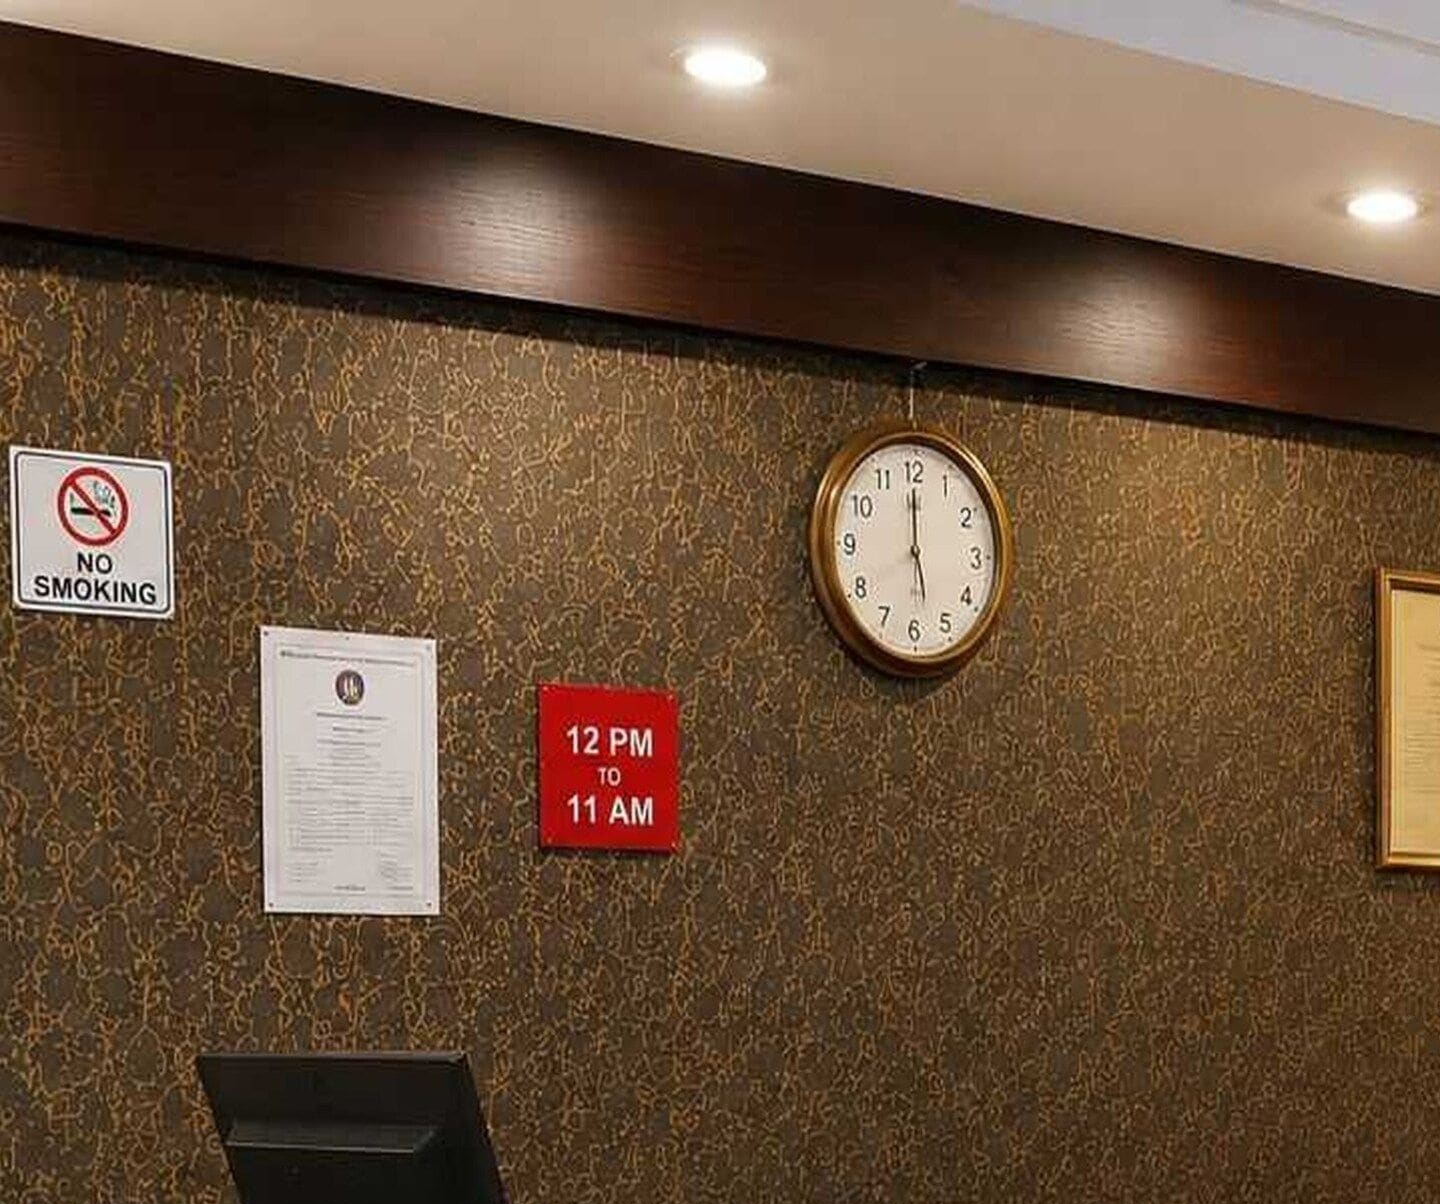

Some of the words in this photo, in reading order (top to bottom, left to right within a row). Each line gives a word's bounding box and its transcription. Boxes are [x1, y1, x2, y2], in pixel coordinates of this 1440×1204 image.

[876, 470, 890, 490] 11
[905, 461, 923, 484] 12
[942, 475, 948, 497] 1
[853, 495, 873, 518] 10
[960, 508, 972, 529] 2
[843, 533, 856, 555] 9
[77, 553, 113, 575] NO
[970, 547, 982, 569] 3
[34, 576, 157, 607] SMOKING
[854, 577, 866, 598] 8
[961, 586, 971, 606] 4
[878, 606, 890, 626] 7
[940, 613, 951, 633] 5
[908, 619, 920, 641] 6
[566, 724, 600, 757] 12
[610, 727, 653, 758] PM
[598, 767, 621, 787] TO
[567, 794, 597, 824] 11
[609, 795, 654, 826] AM
